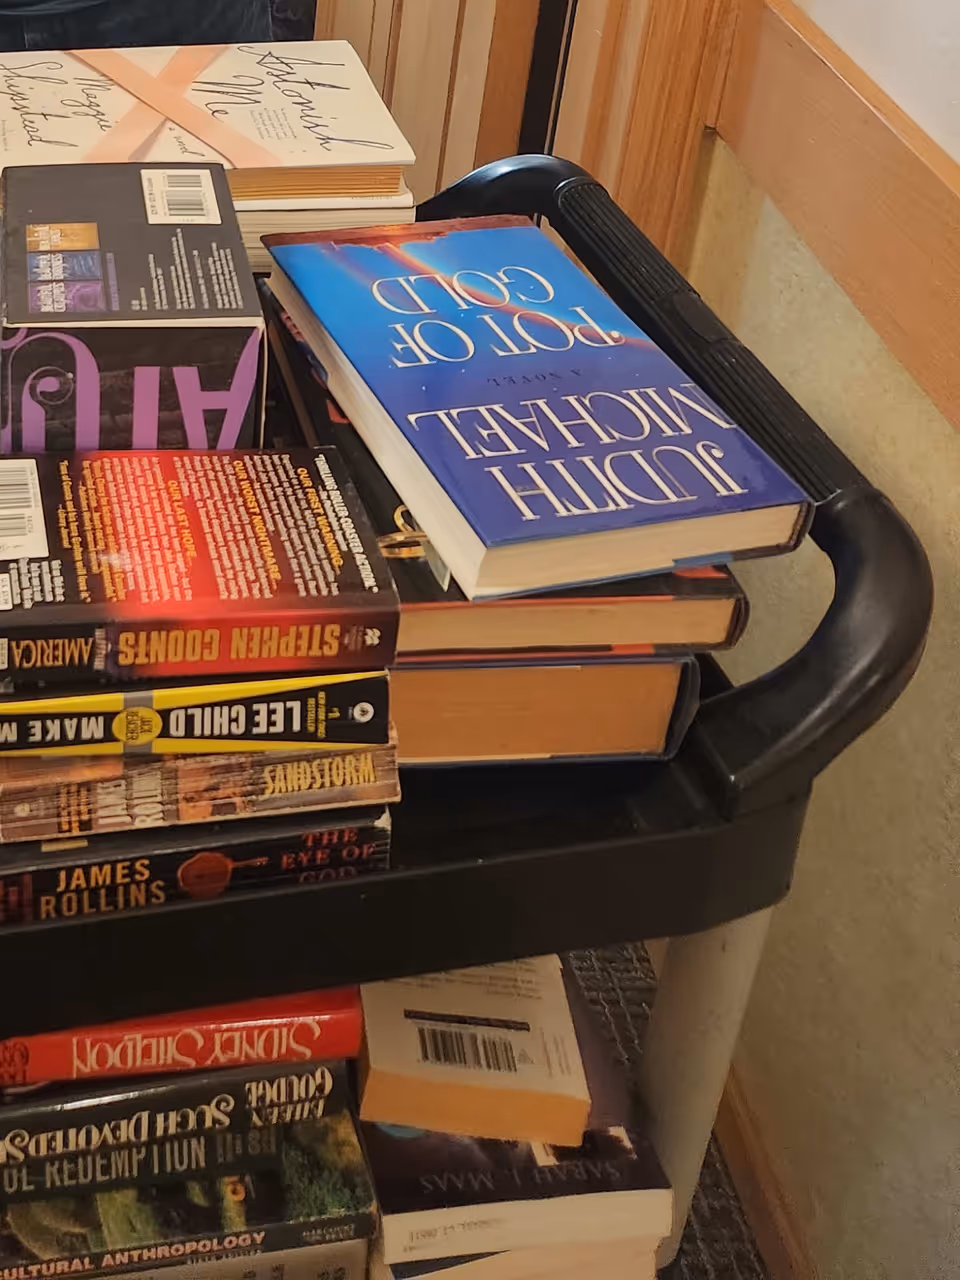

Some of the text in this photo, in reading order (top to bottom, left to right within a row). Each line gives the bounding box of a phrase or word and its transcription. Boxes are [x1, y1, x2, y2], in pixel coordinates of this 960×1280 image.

[192, 74, 265, 124] Me
[237, 46, 394, 152] Astonish
[371, 265, 555, 315] GOLD
[390, 306, 625, 368] POT OF
[488, 370, 568, 387] NOVEL
[408, 383, 738, 460] MICHAEL
[233, 460, 248, 479] OUR
[485, 441, 748, 520] JUDITH
[168, 480, 181, 501] OUR
[240, 479, 260, 514] WORST
[297, 467, 313, 487] OUR
[305, 488, 324, 515] FIRST
[173, 501, 189, 529] LAST
[13, 637, 94, 668] AMERICA
[118, 628, 220, 665] COONTS
[231, 624, 340, 658] STEPHEN
[29, 716, 105, 744] MAKE
[169, 700, 301, 738] LEE CHILD
[264, 753, 376, 796] SANDSTORM
[280, 841, 377, 871] EYE OF
[302, 828, 359, 847] THE
[57, 859, 151, 893] JAMES
[40, 881, 166, 920] ROLLINS
[73, 1016, 323, 1079] SIDNEY SHELDON
[245, 1065, 333, 1109] GOUDGE
[156, 1095, 236, 1135] SUCH
[36, 1109, 153, 1160] DEVOTED
[420, 1172, 495, 1194] MAAS
[535, 1160, 621, 1182] SARAH
[102, 1228, 267, 1267] ANTHROPOLOGY
